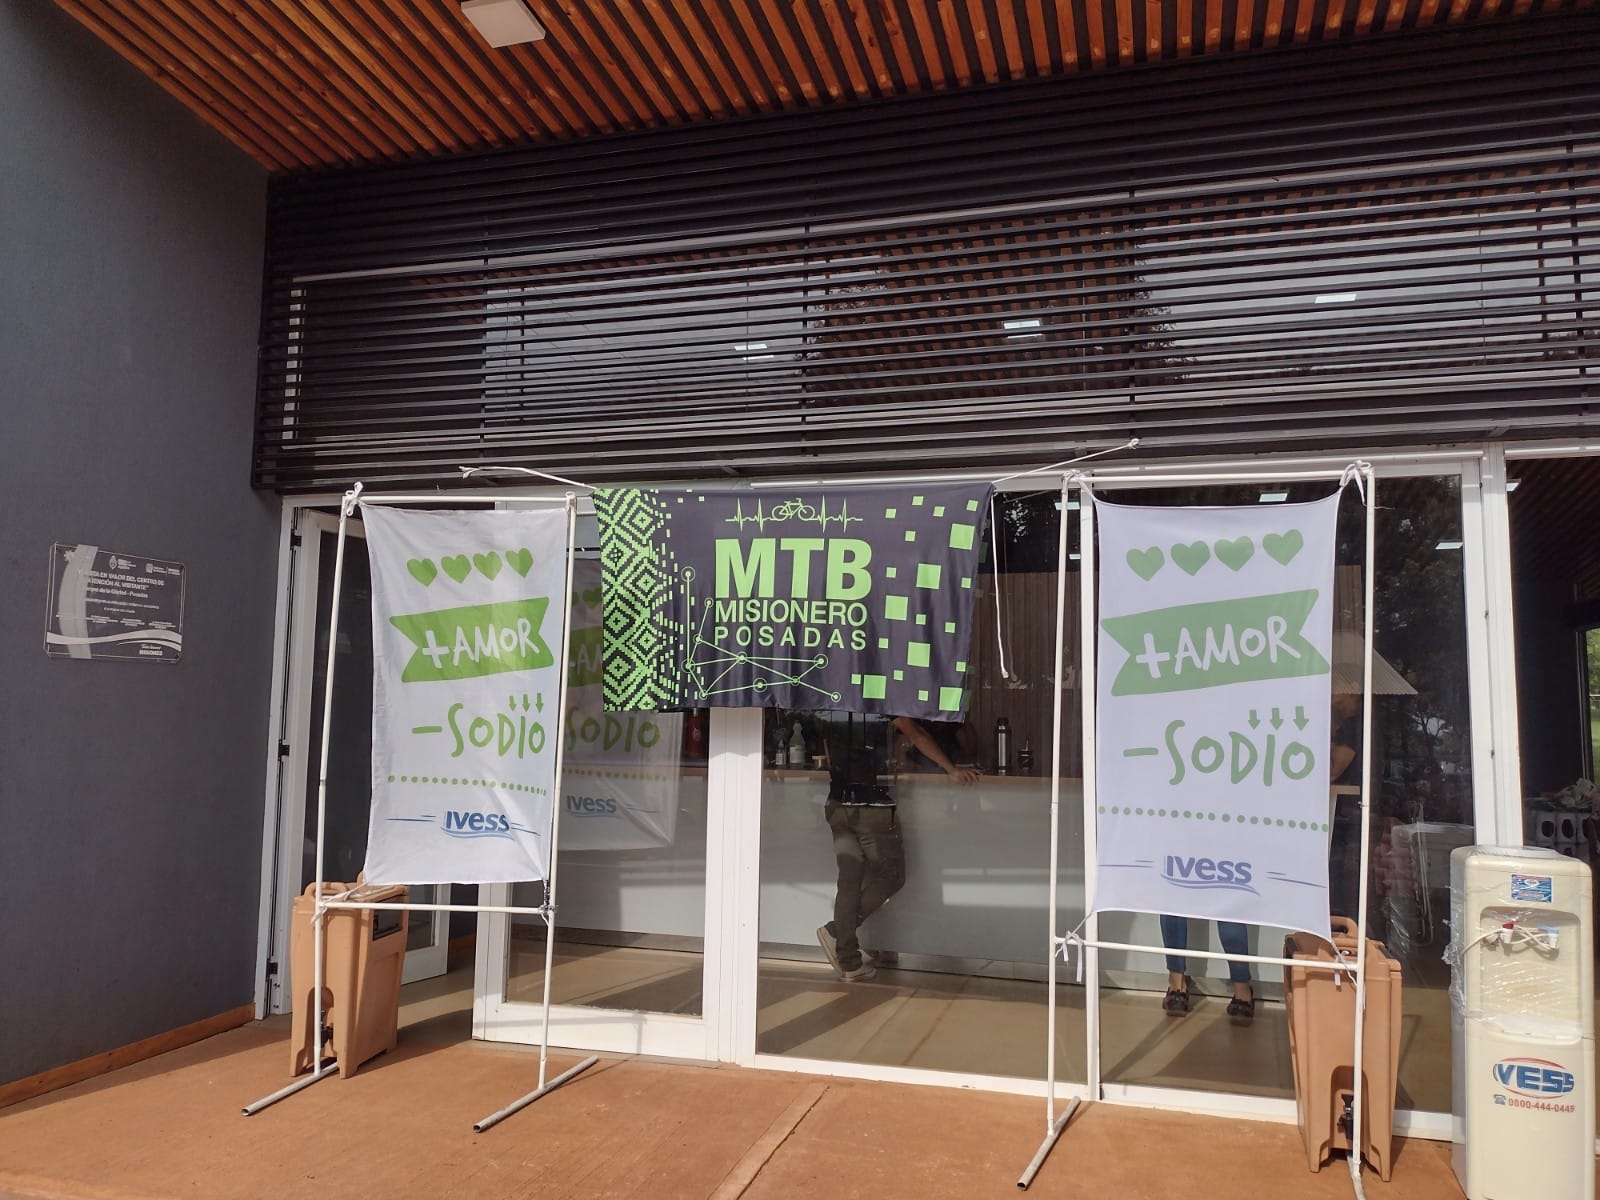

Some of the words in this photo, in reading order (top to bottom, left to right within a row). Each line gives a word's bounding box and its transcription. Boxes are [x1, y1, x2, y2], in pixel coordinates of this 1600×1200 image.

[714, 537, 873, 601] MTB
[714, 600, 868, 627] MISIONERO
[714, 625, 867, 651] POSADAS
